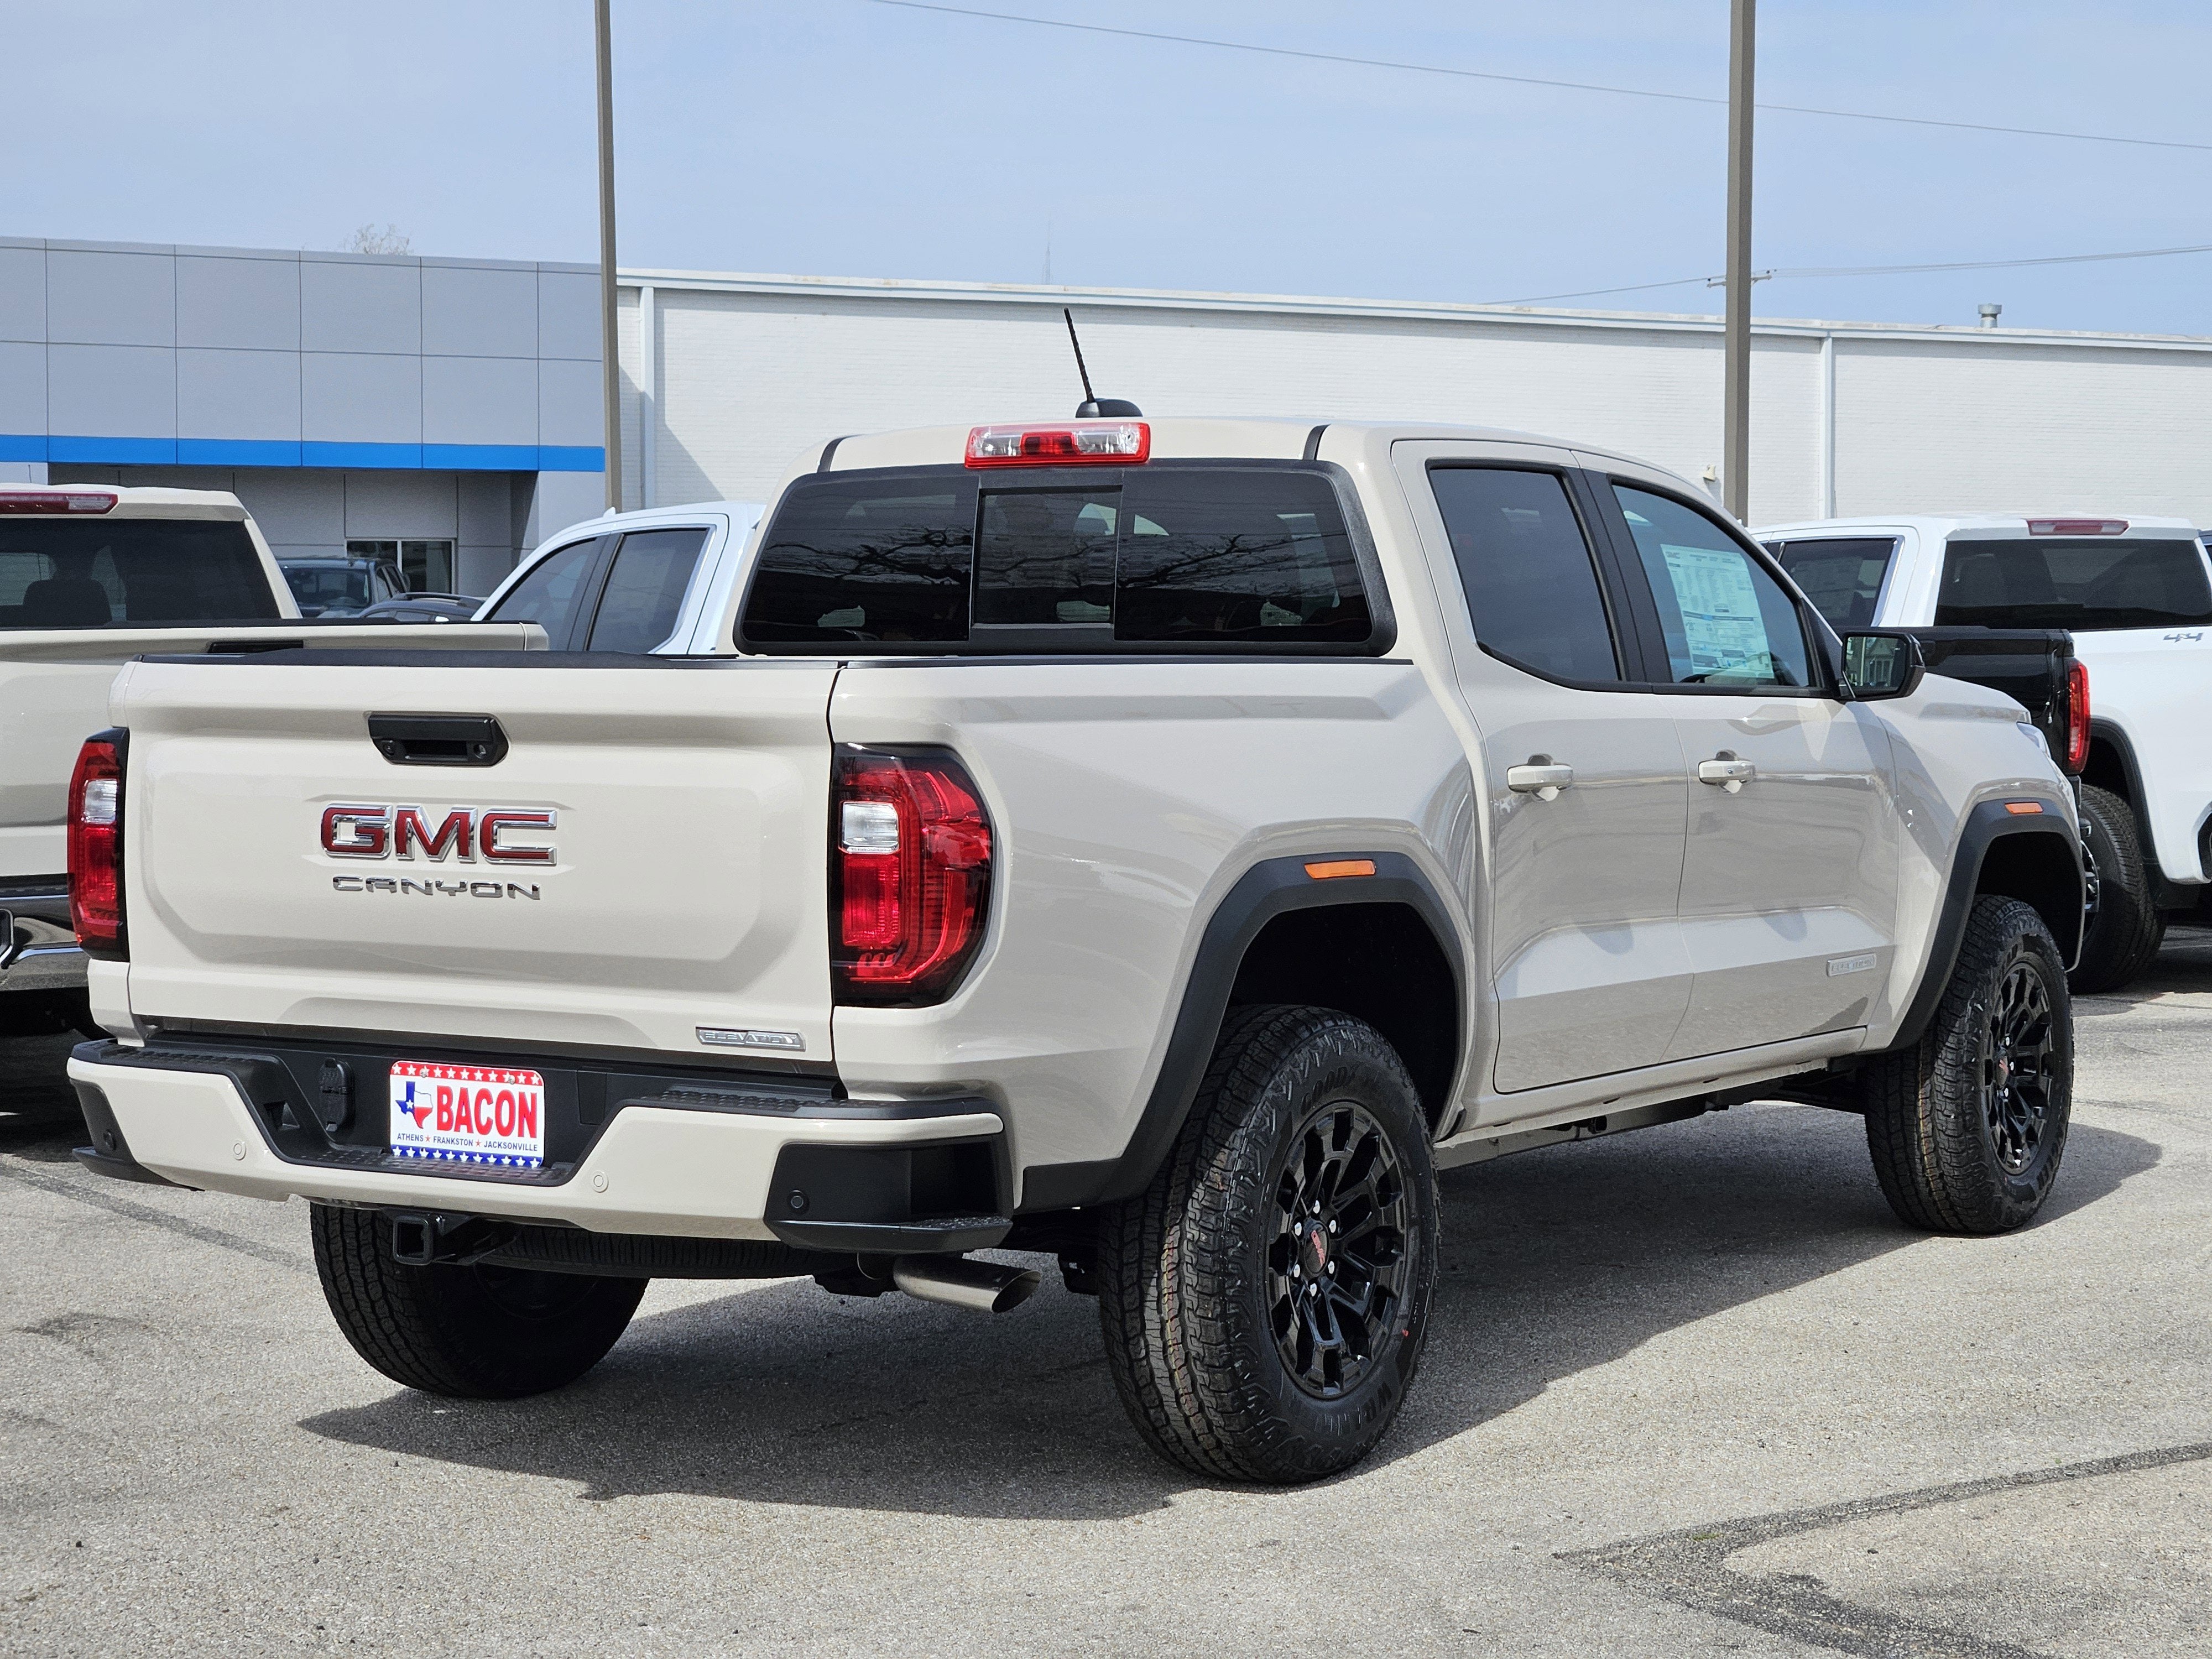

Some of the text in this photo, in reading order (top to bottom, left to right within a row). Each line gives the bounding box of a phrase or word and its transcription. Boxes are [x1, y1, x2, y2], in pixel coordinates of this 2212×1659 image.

[321, 803, 557, 865] GMC
[332, 875, 540, 900] CANYON
[436, 1085, 538, 1138] BACON
[397, 1133, 538, 1151] ATHENS FRANKSTON JACKSONVILLE
